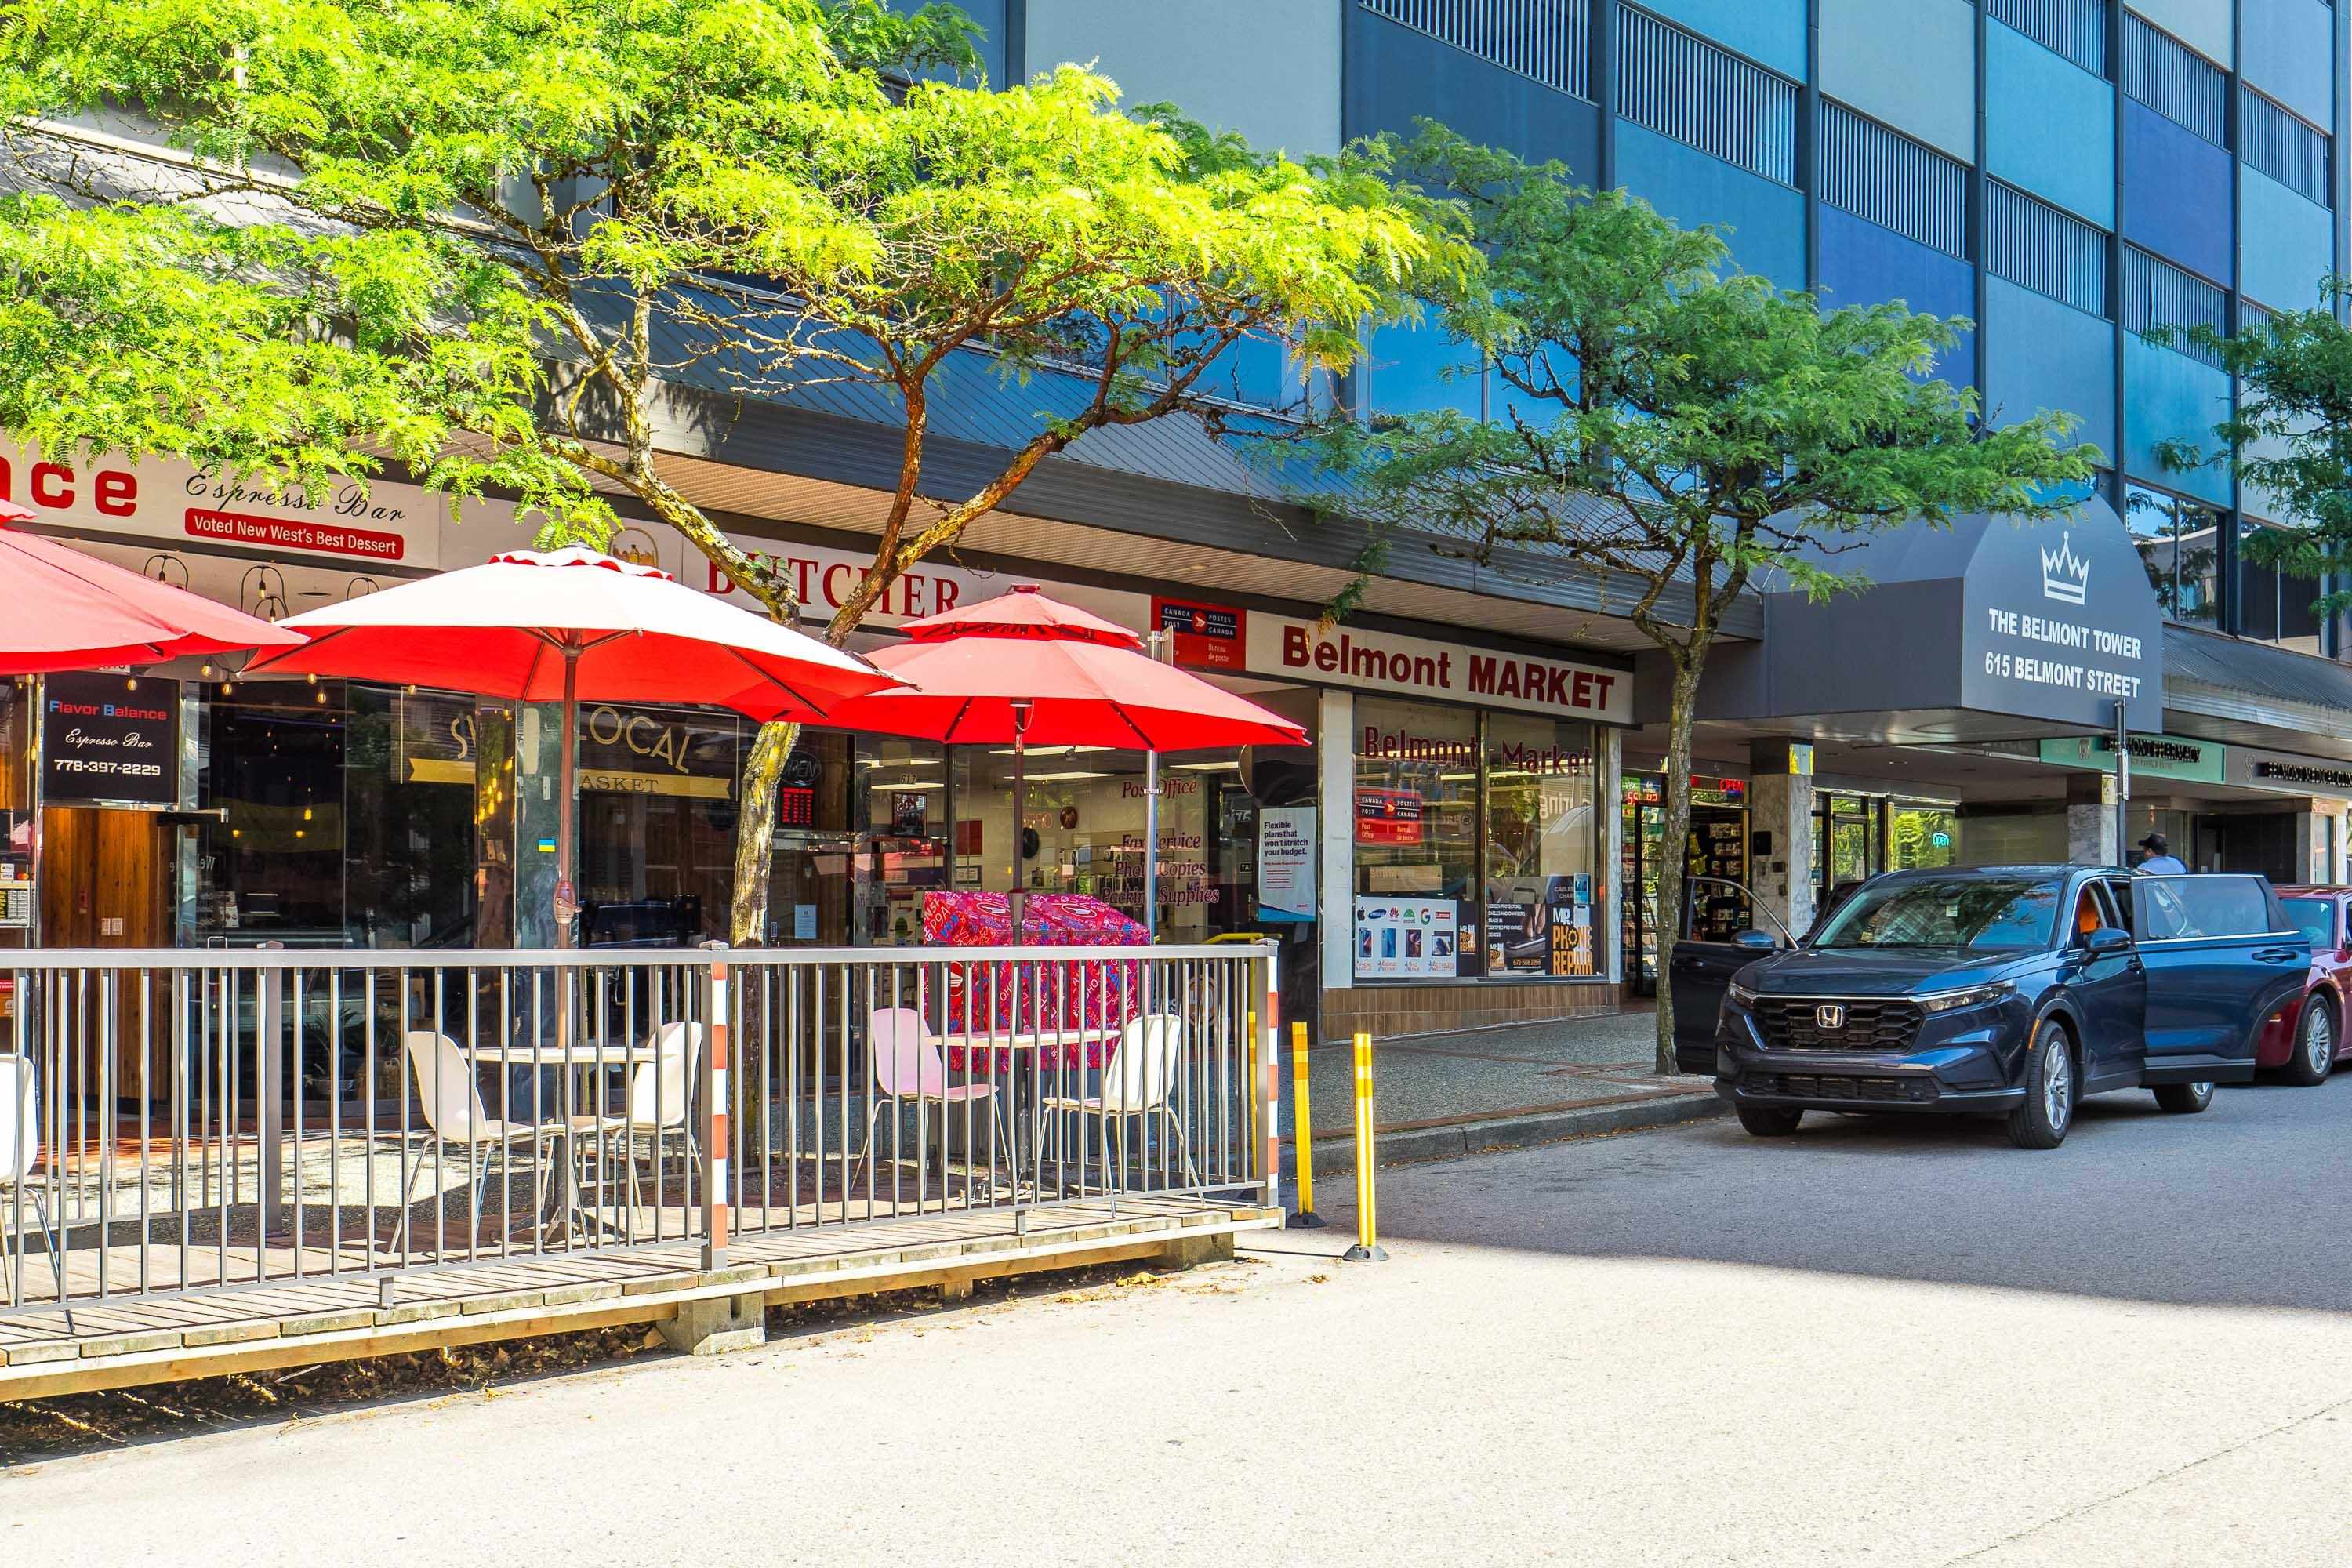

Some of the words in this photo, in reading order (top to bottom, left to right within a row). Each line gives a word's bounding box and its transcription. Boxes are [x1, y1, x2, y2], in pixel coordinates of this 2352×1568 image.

[0, 453, 137, 517] ce
[335, 484, 405, 521] Bar
[194, 515, 233, 534] Voted
[237, 521, 267, 538] New
[270, 524, 313, 543] West's
[317, 531, 343, 548] Best
[348, 534, 396, 554] Dessert
[705, 552, 959, 618] BTCER
[1164, 608, 1191, 618] CANADA
[1208, 614, 1231, 623] POSTES
[1208, 626, 1234, 636] CANADA
[1988, 608, 2017, 636] THE
[2021, 615, 2089, 649] BELMONT
[2092, 630, 2142, 659] TOWER
[1208, 643, 1226, 652] Bureau
[1283, 626, 1451, 689] Belmont
[1468, 655, 1615, 710] MARKET
[1985, 652, 2011, 677] 615
[2014, 656, 2084, 688] BELMONT
[2086, 670, 2140, 698] STREET
[49, 700, 100, 717] Flavor
[103, 704, 167, 720] Balance
[65, 728, 118, 748] Espresso
[122, 732, 153, 748] Bar
[580, 706, 690, 774] OCAL
[1363, 726, 1477, 769] Belmont
[1501, 740, 1593, 778] Market
[54, 759, 161, 776] 778-397-2229
[580, 775, 659, 793] ASKET
[1121, 782, 1145, 798] Pos
[1719, 779, 1744, 792] OPEN
[1264, 821, 1292, 829] Flexible
[1264, 830, 1283, 839] plans
[1283, 829, 1298, 838] that
[1156, 832, 1201, 849] ervice
[1284, 838, 1308, 847] stretch
[1264, 848, 1279, 857] your
[1281, 847, 1307, 857] budget.
[1159, 859, 1207, 880] Copies
[1103, 887, 1145, 905] Packin
[1158, 884, 1220, 905] Supplies
[1553, 907, 1573, 925] MR.
[1553, 950, 1593, 975] REPAIR
